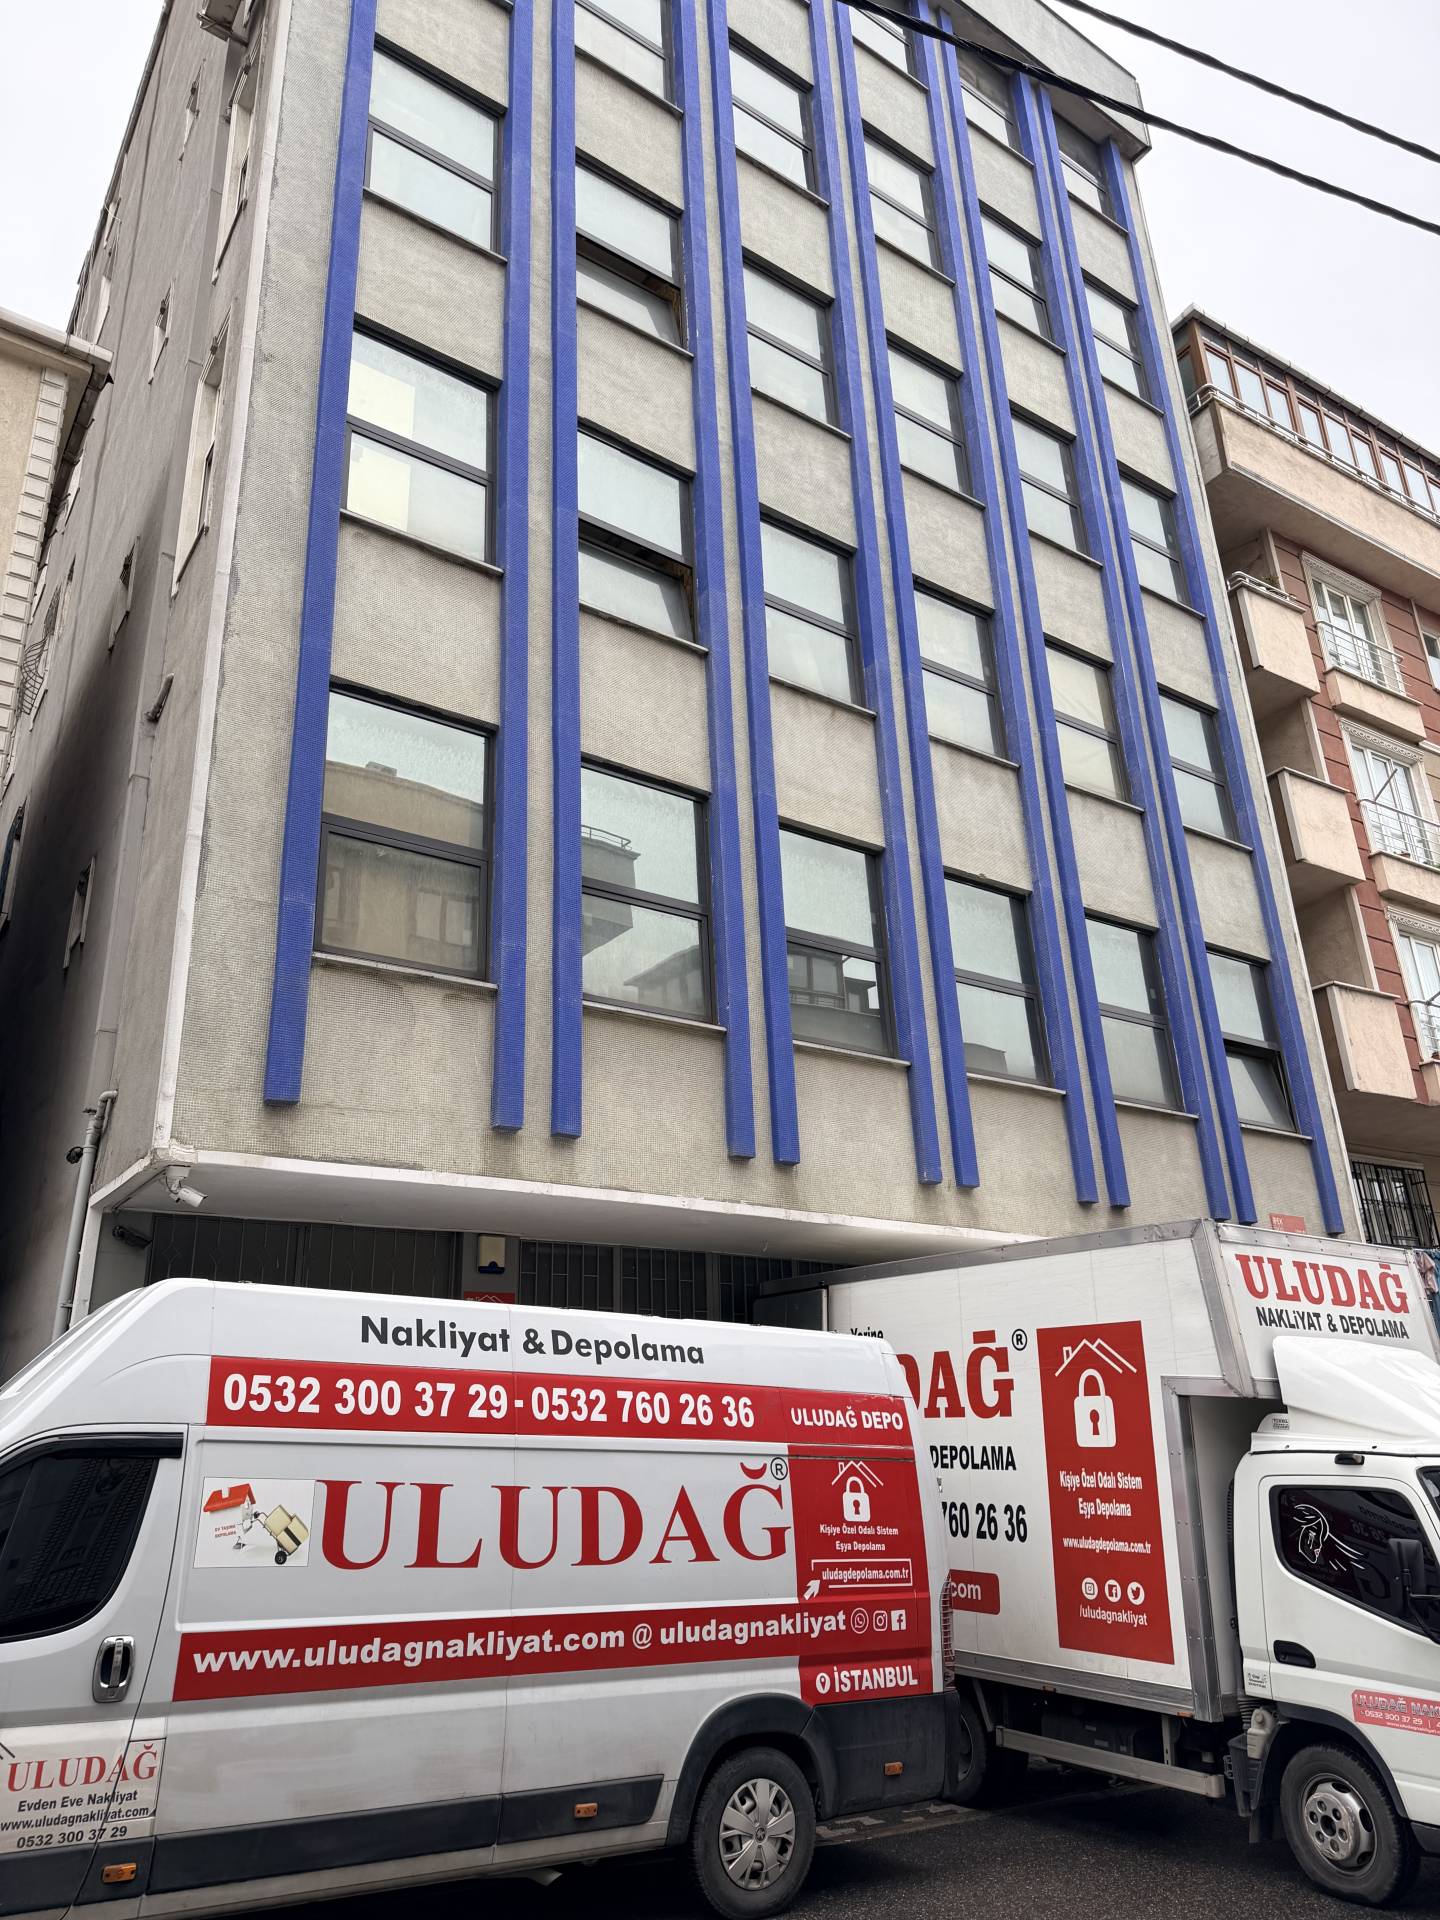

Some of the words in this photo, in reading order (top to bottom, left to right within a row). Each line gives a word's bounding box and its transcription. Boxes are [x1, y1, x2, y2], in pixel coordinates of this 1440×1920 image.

[1235, 1253, 1410, 1314] ULUDAĞ
[1326, 1313, 1339, 1333] &
[1339, 1314, 1410, 1340] DEPOLAMA
[361, 1315, 511, 1358] Nakliyat
[522, 1328, 547, 1355] &
[552, 1329, 705, 1365] Depolama
[223, 1373, 321, 1414] 0532
[334, 1378, 402, 1416] 300
[414, 1382, 456, 1417] 37
[468, 1384, 508, 1419] 29
[532, 1386, 608, 1423] 0532
[616, 1390, 670, 1425] 760
[679, 1393, 714, 1427] 26
[722, 1395, 755, 1428] 36
[791, 1406, 858, 1428] ULUDAĞ
[861, 1410, 904, 1431] DEPO
[930, 1445, 1017, 1471] DEPOLAMA
[1059, 1471, 1081, 1492] Kişiye
[1081, 1468, 1097, 1489] Özel
[1097, 1472, 1117, 1489] Odalı
[1117, 1472, 1143, 1490] Sistem
[316, 1461, 792, 1570] ULUDAĞ
[1078, 1498, 1095, 1519] Eşya
[1096, 1498, 1132, 1519] Depolama
[819, 1524, 841, 1536] Kişiye
[842, 1522, 857, 1535] Özel
[858, 1525, 876, 1535] Odalı
[876, 1525, 899, 1536] Sistem
[976, 1502, 999, 1541] 26
[1004, 1504, 1028, 1543] 36
[835, 1540, 852, 1553] Eşya
[853, 1541, 886, 1552] Depolama
[1063, 1536, 1151, 1554] www.uludagdepolama.com.tr
[822, 1567, 910, 1583] uludagdepolama.com.tr
[193, 1628, 625, 1673] www.uludagnakliyat.com
[632, 1623, 653, 1650] @
[660, 1610, 846, 1646] uludagnakliyat
[834, 1666, 918, 1693] İSTANBUL
[1354, 1694, 1408, 1713] ULUDAĞ
[1364, 1709, 1383, 1719] 0532
[1385, 1713, 1400, 1721] 300
[1401, 1715, 1411, 1723] 37
[1412, 1717, 1423, 1725] 29
[8, 1744, 158, 1793] ULUDAĞ
[17, 1799, 57, 1813] Evden
[60, 1796, 84, 1809] Eve
[87, 1790, 138, 1806] Nakliyat
[1, 1806, 149, 1831] www.uludagnakliyat.com
[16, 1834, 53, 1849] 0532
[57, 1831, 84, 1844] 300
[88, 1828, 106, 1840] 37
[111, 1826, 128, 1838] 29
